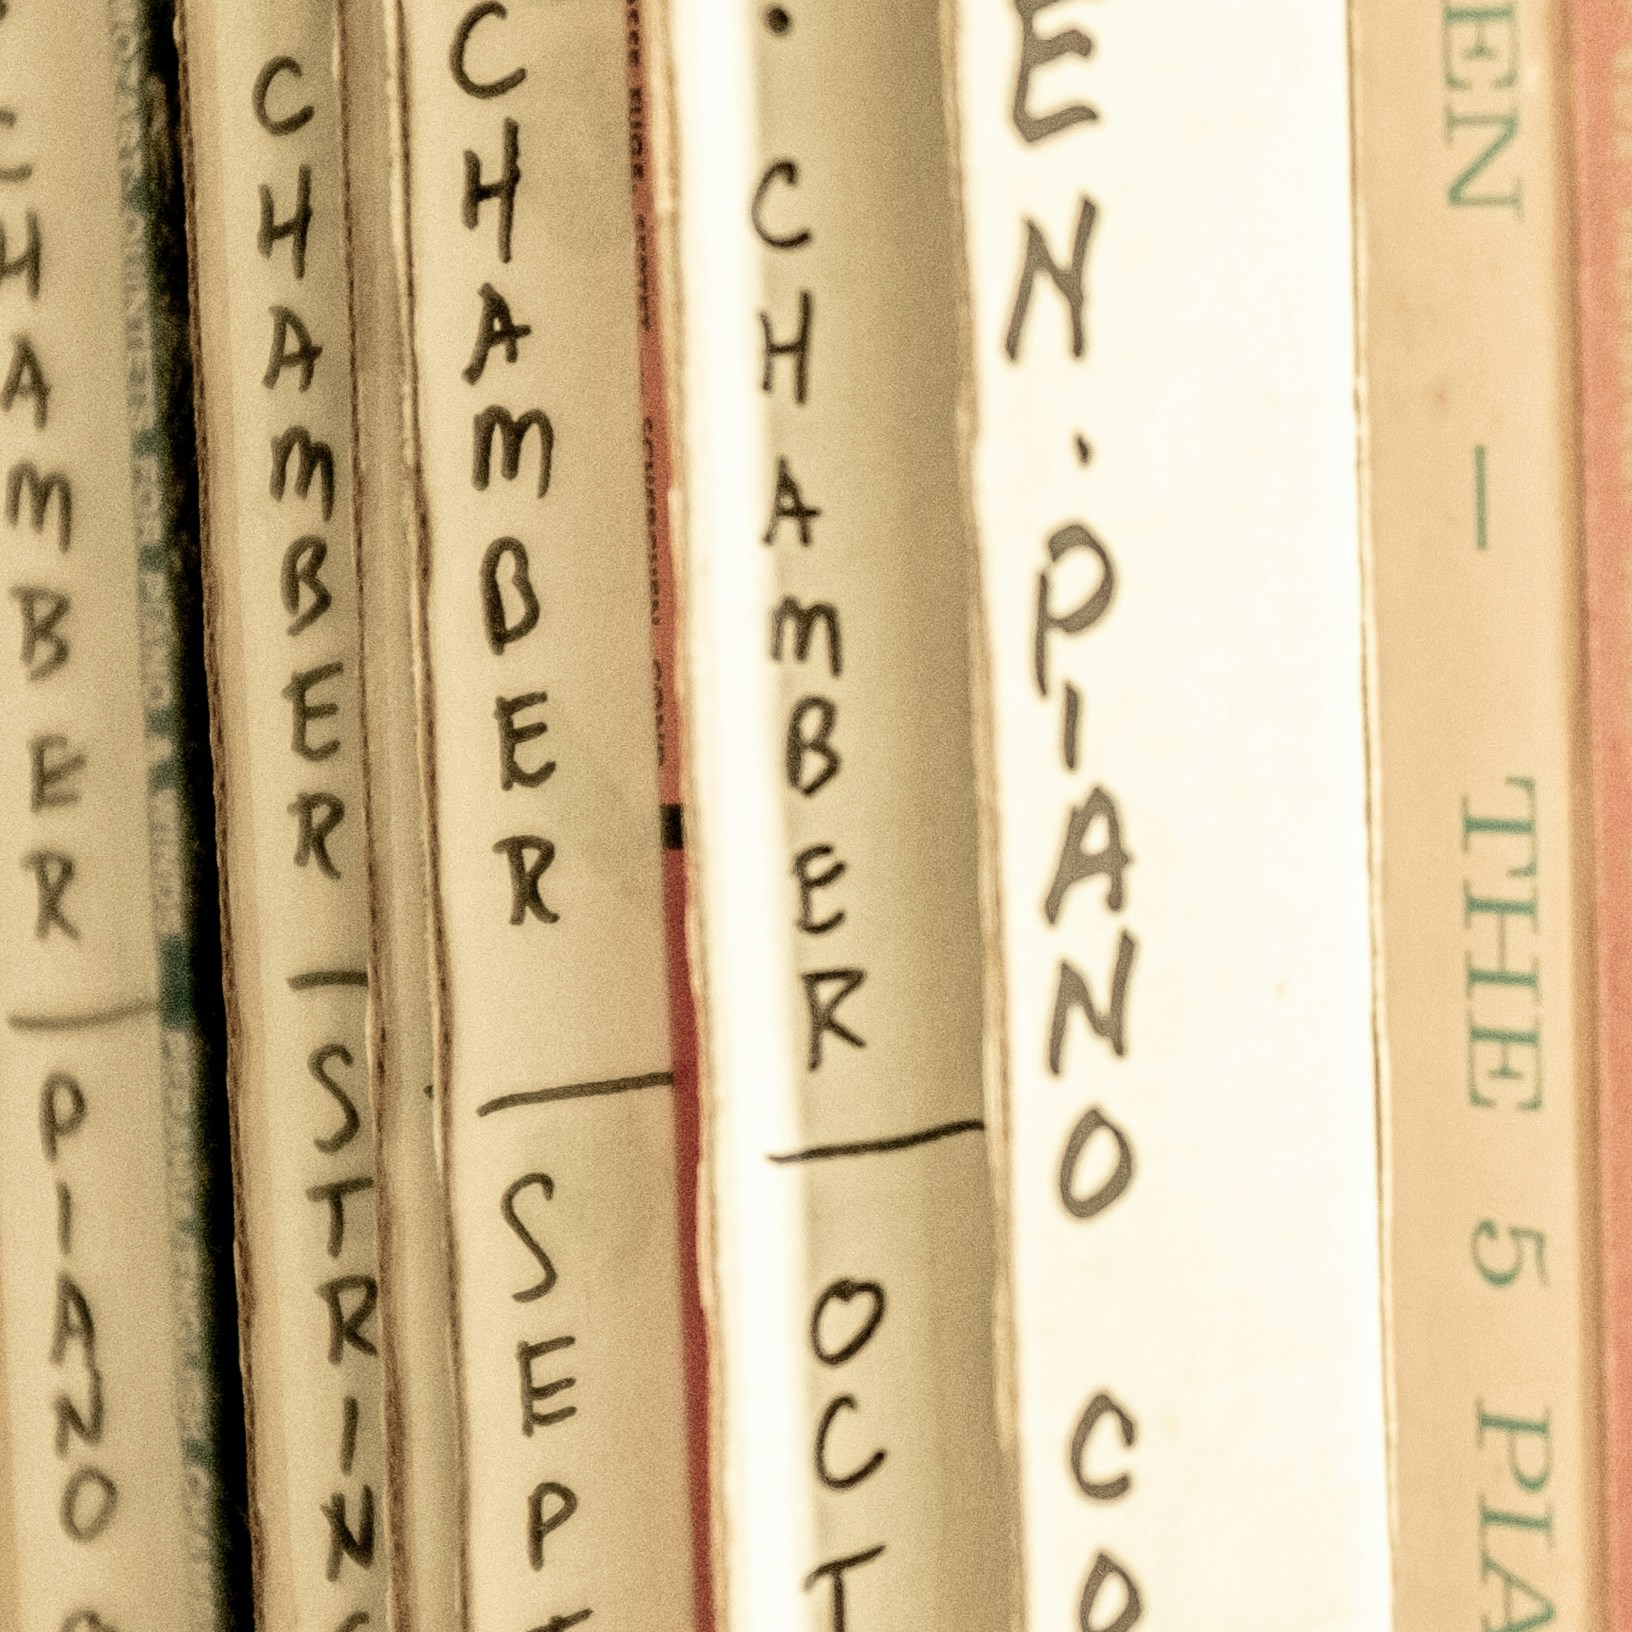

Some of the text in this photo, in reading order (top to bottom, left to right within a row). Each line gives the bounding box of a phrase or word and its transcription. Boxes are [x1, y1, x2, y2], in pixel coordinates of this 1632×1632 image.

[252, 54, 345, 882] CHAMBER
[450, 0, 562, 926] CHAMBER
[749, 155, 871, 1074] CHAMBER
[1033, 519, 1140, 1224] PIANO
[1460, 776, 1543, 1115] THE
[38, 1070, 121, 1546] PIANO
[1469, 1216, 1550, 1291] 5
